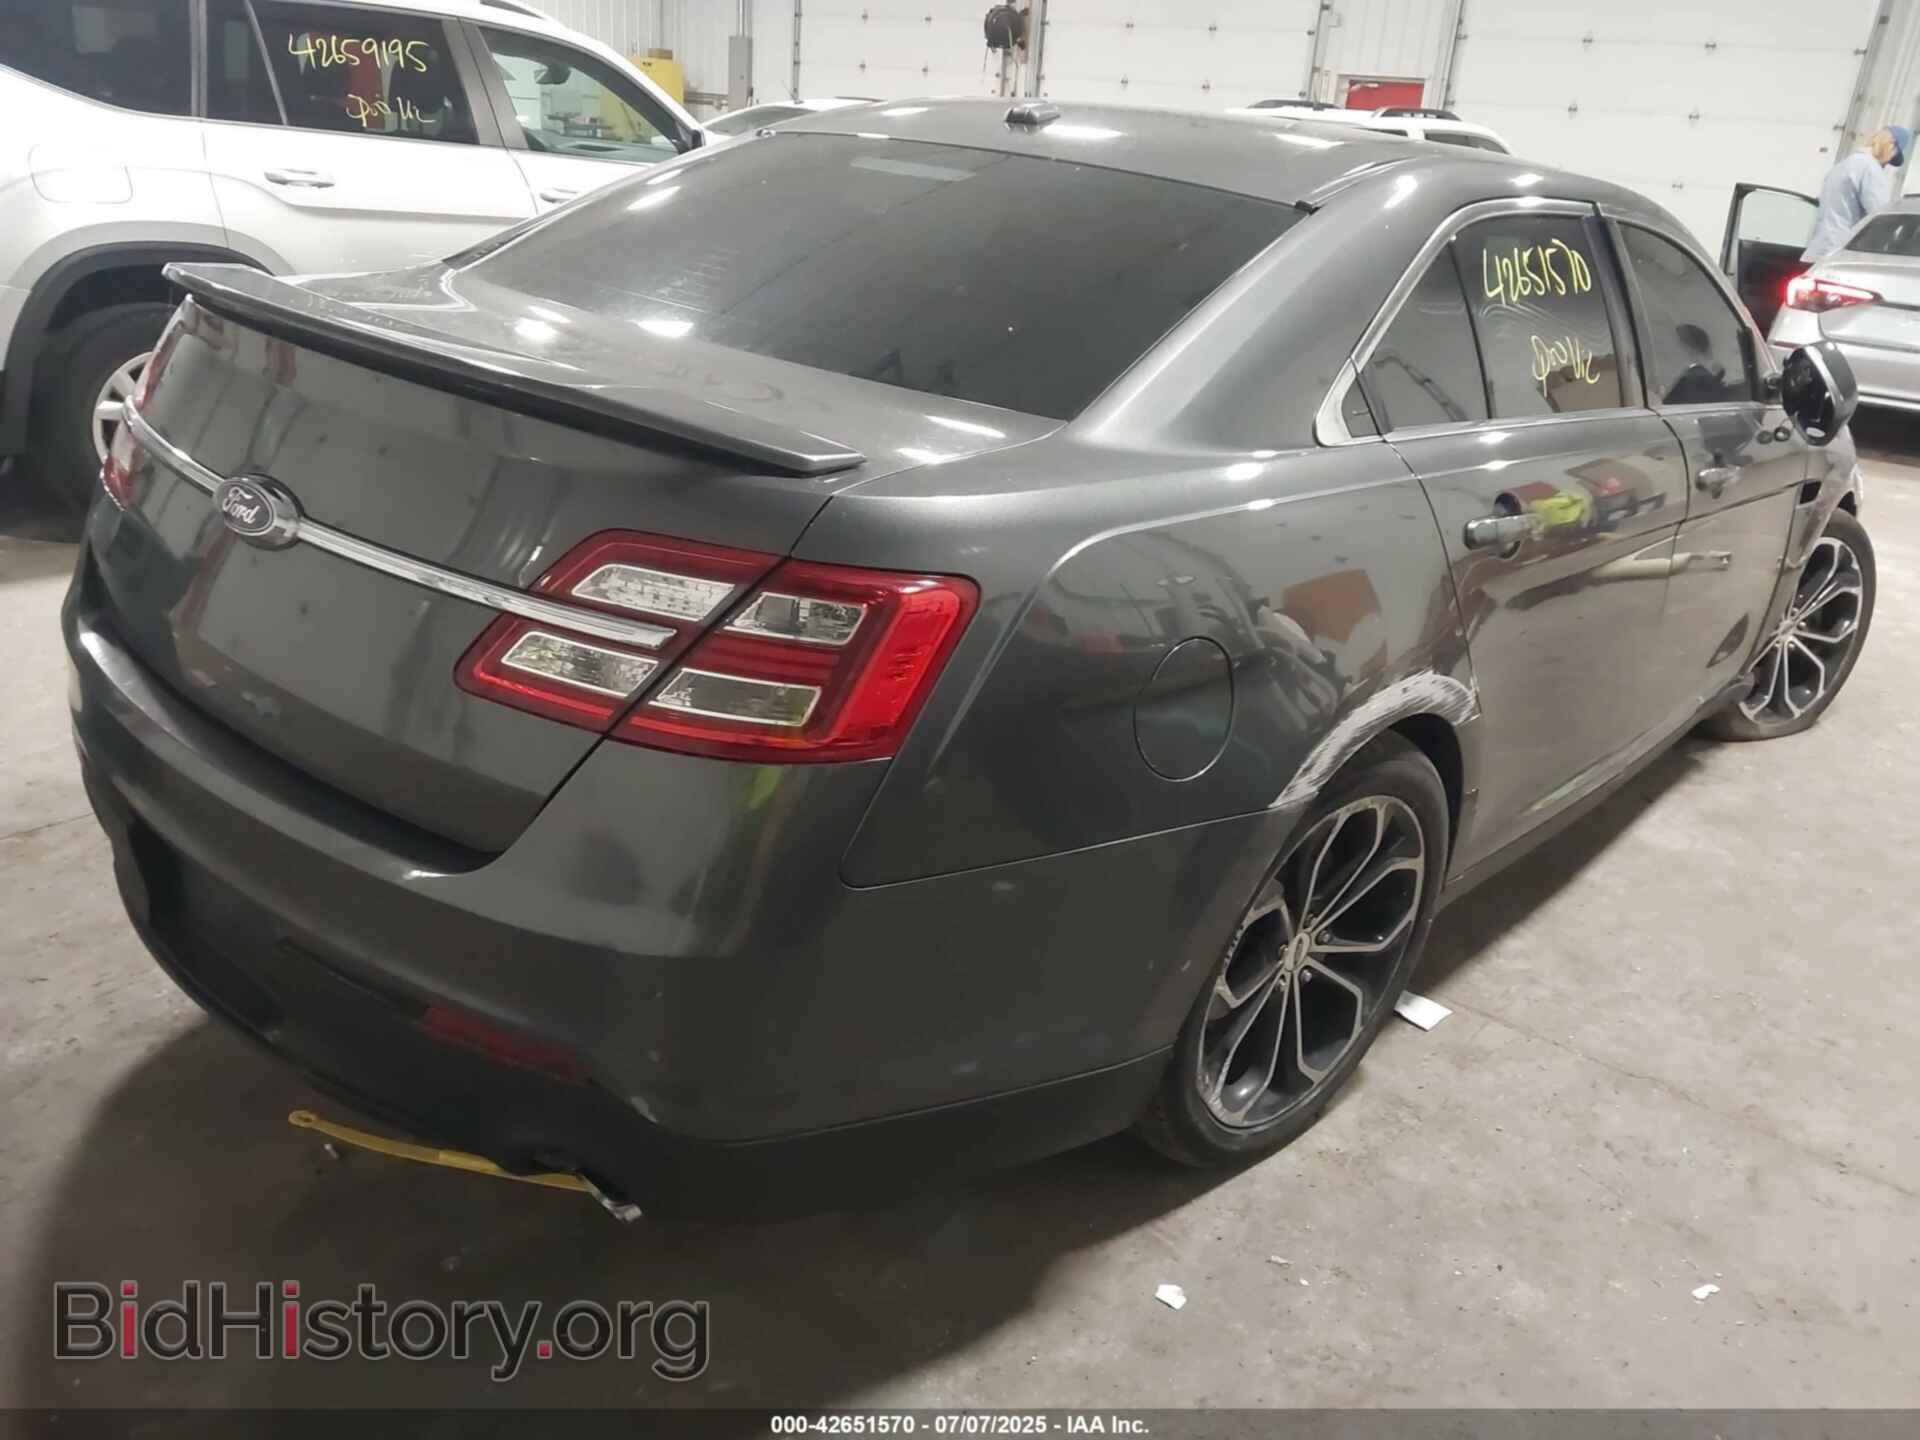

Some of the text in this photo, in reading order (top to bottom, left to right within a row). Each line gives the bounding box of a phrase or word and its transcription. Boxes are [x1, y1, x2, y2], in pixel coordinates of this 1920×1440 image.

[288, 33, 430, 73] 42659195
[1483, 238, 1592, 306] 42651570
[222, 486, 261, 524] Ford
